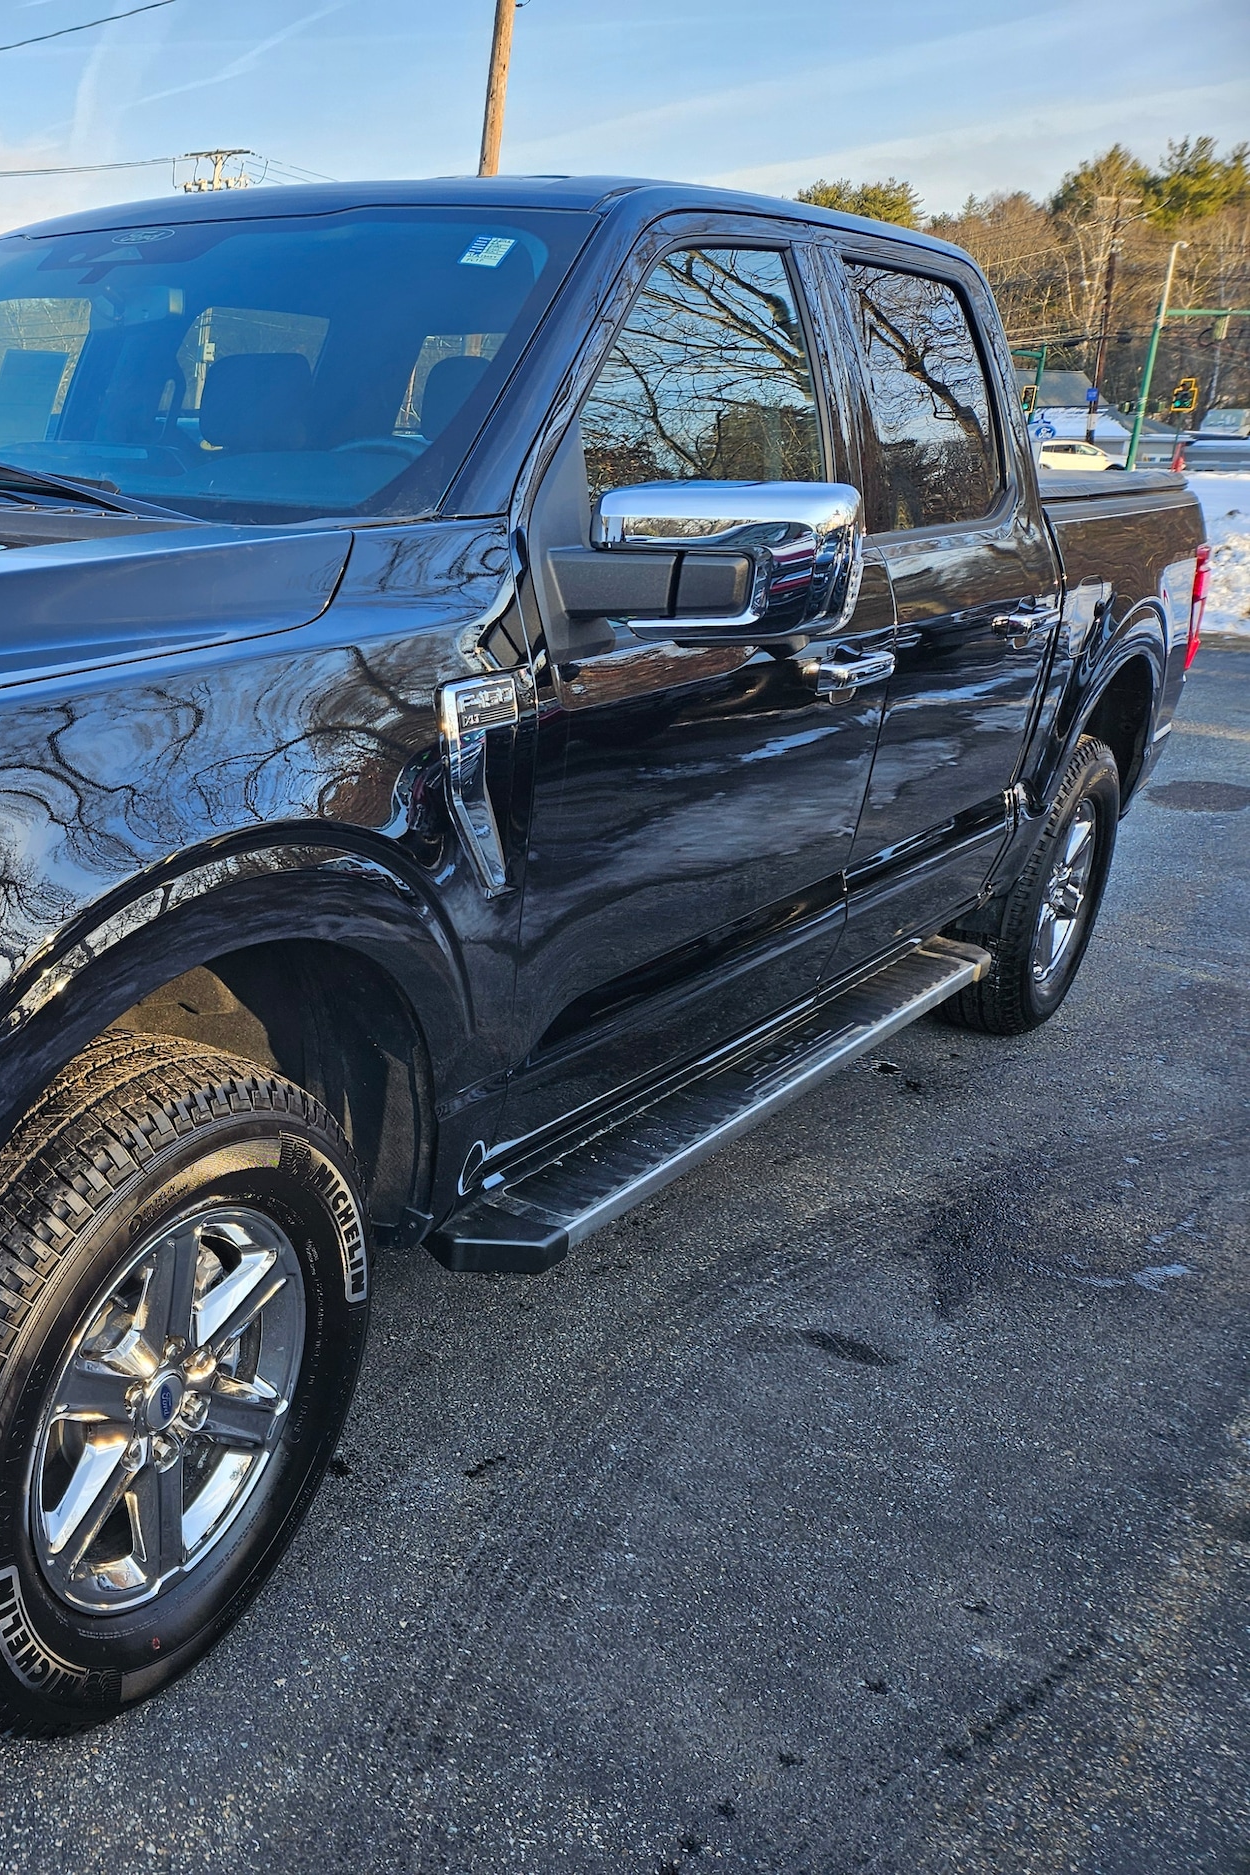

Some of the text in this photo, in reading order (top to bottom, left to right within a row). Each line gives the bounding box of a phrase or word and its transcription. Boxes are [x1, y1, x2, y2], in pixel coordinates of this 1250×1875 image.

[119, 230, 166, 242] Ford
[457, 687, 513, 714] F-150
[310, 1161, 366, 1295] MICHELIN
[161, 1391, 171, 1417] Ford
